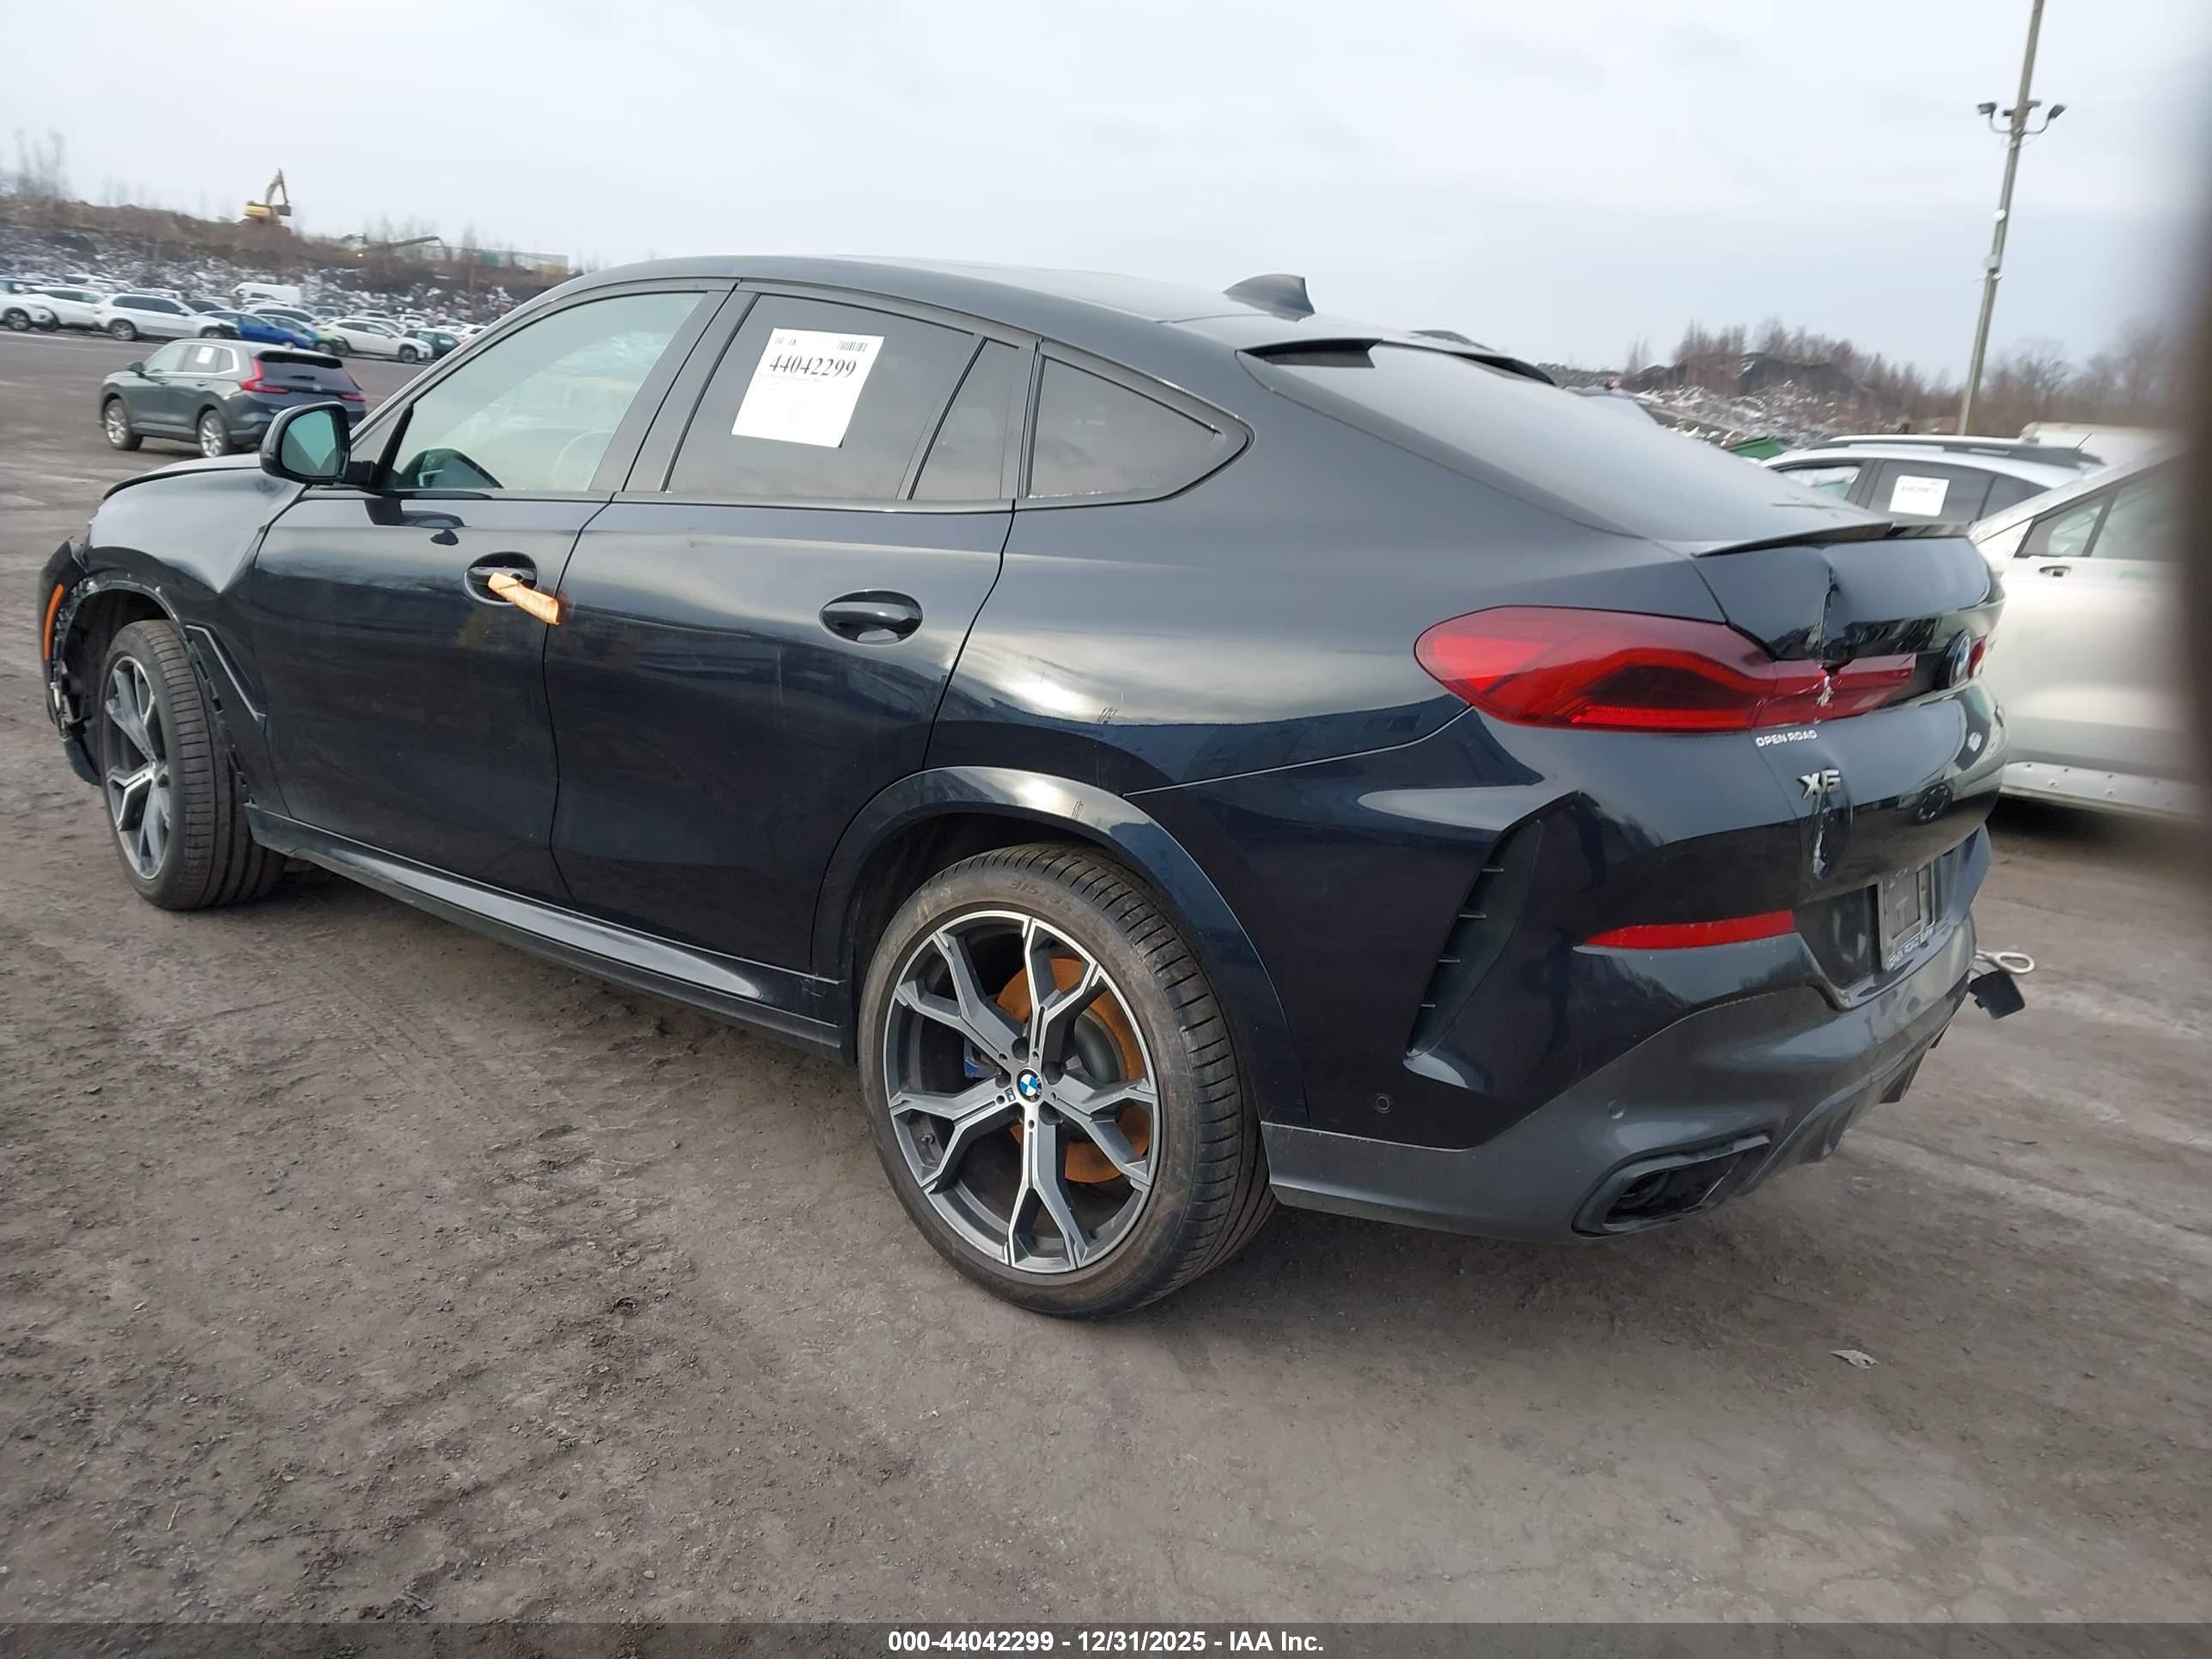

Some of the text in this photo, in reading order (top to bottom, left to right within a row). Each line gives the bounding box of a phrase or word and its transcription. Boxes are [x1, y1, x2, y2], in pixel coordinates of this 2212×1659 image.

[769, 354, 857, 378] 44042299
[1755, 729, 1818, 747] OPEN ROAD
